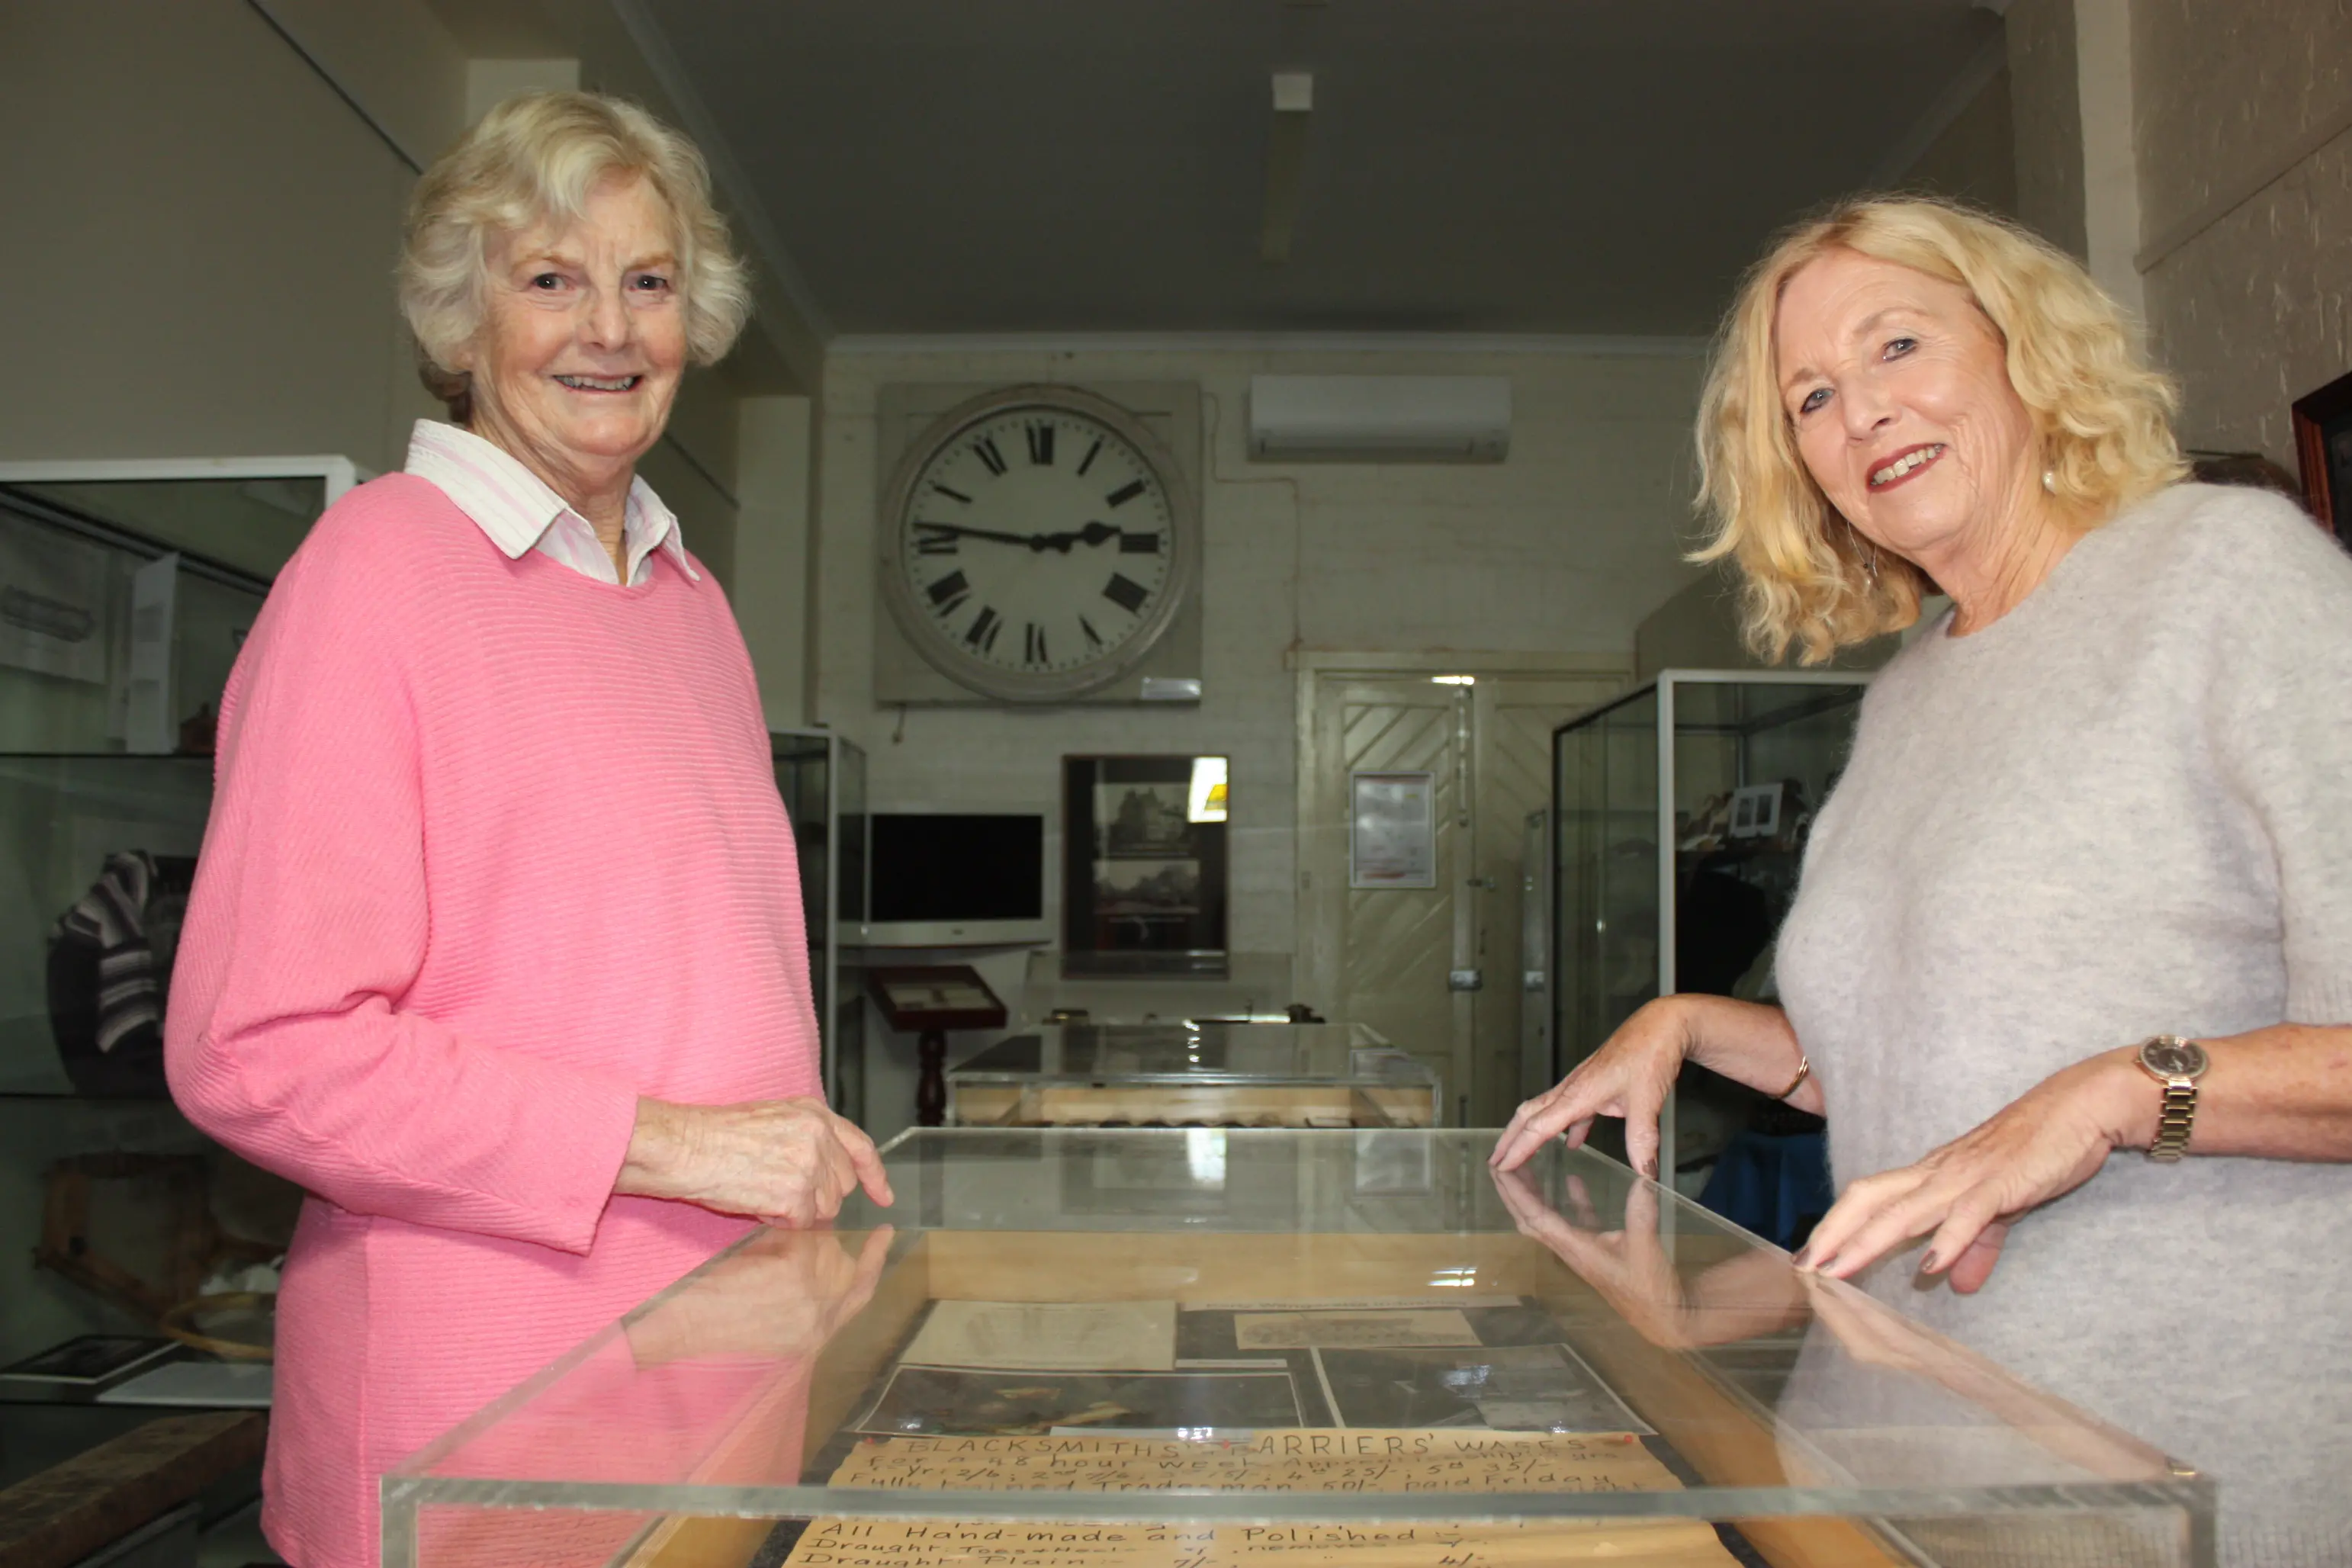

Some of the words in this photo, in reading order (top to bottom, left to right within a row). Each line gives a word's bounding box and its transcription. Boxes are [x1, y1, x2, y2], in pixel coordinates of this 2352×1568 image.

[1049, 1452, 1133, 1469] hour
[820, 1522, 873, 1537] All
[904, 1526, 1127, 1541] Hand-made
[1146, 1528, 1215, 1541] and
[1239, 1526, 1415, 1542] Polished
